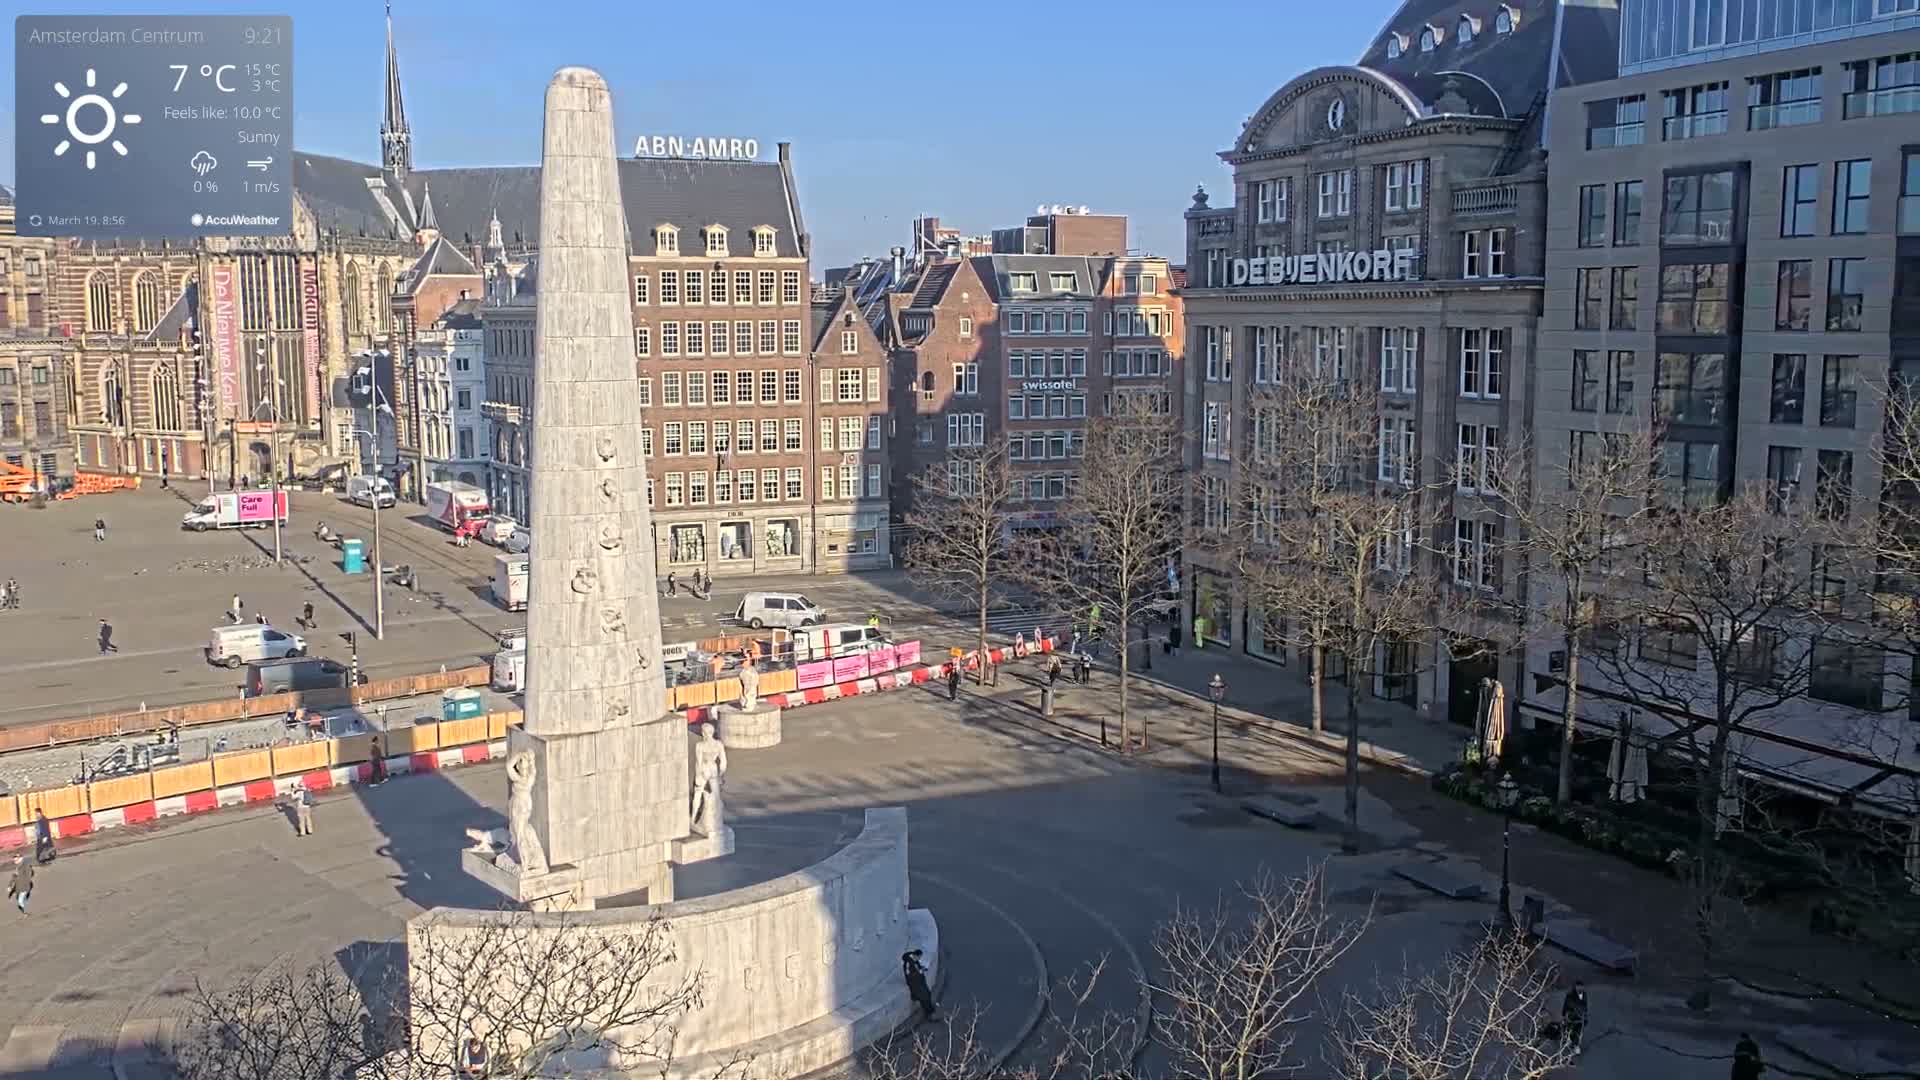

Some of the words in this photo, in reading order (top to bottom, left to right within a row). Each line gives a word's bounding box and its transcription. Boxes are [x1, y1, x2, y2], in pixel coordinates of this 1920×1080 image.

[214, 271, 231, 296] De
[1233, 257, 1265, 285] DE
[1269, 248, 1414, 284] BIJENKORF
[303, 269, 318, 329] Mokum
[216, 300, 234, 367] Nieuwe
[220, 371, 237, 411] Kerk
